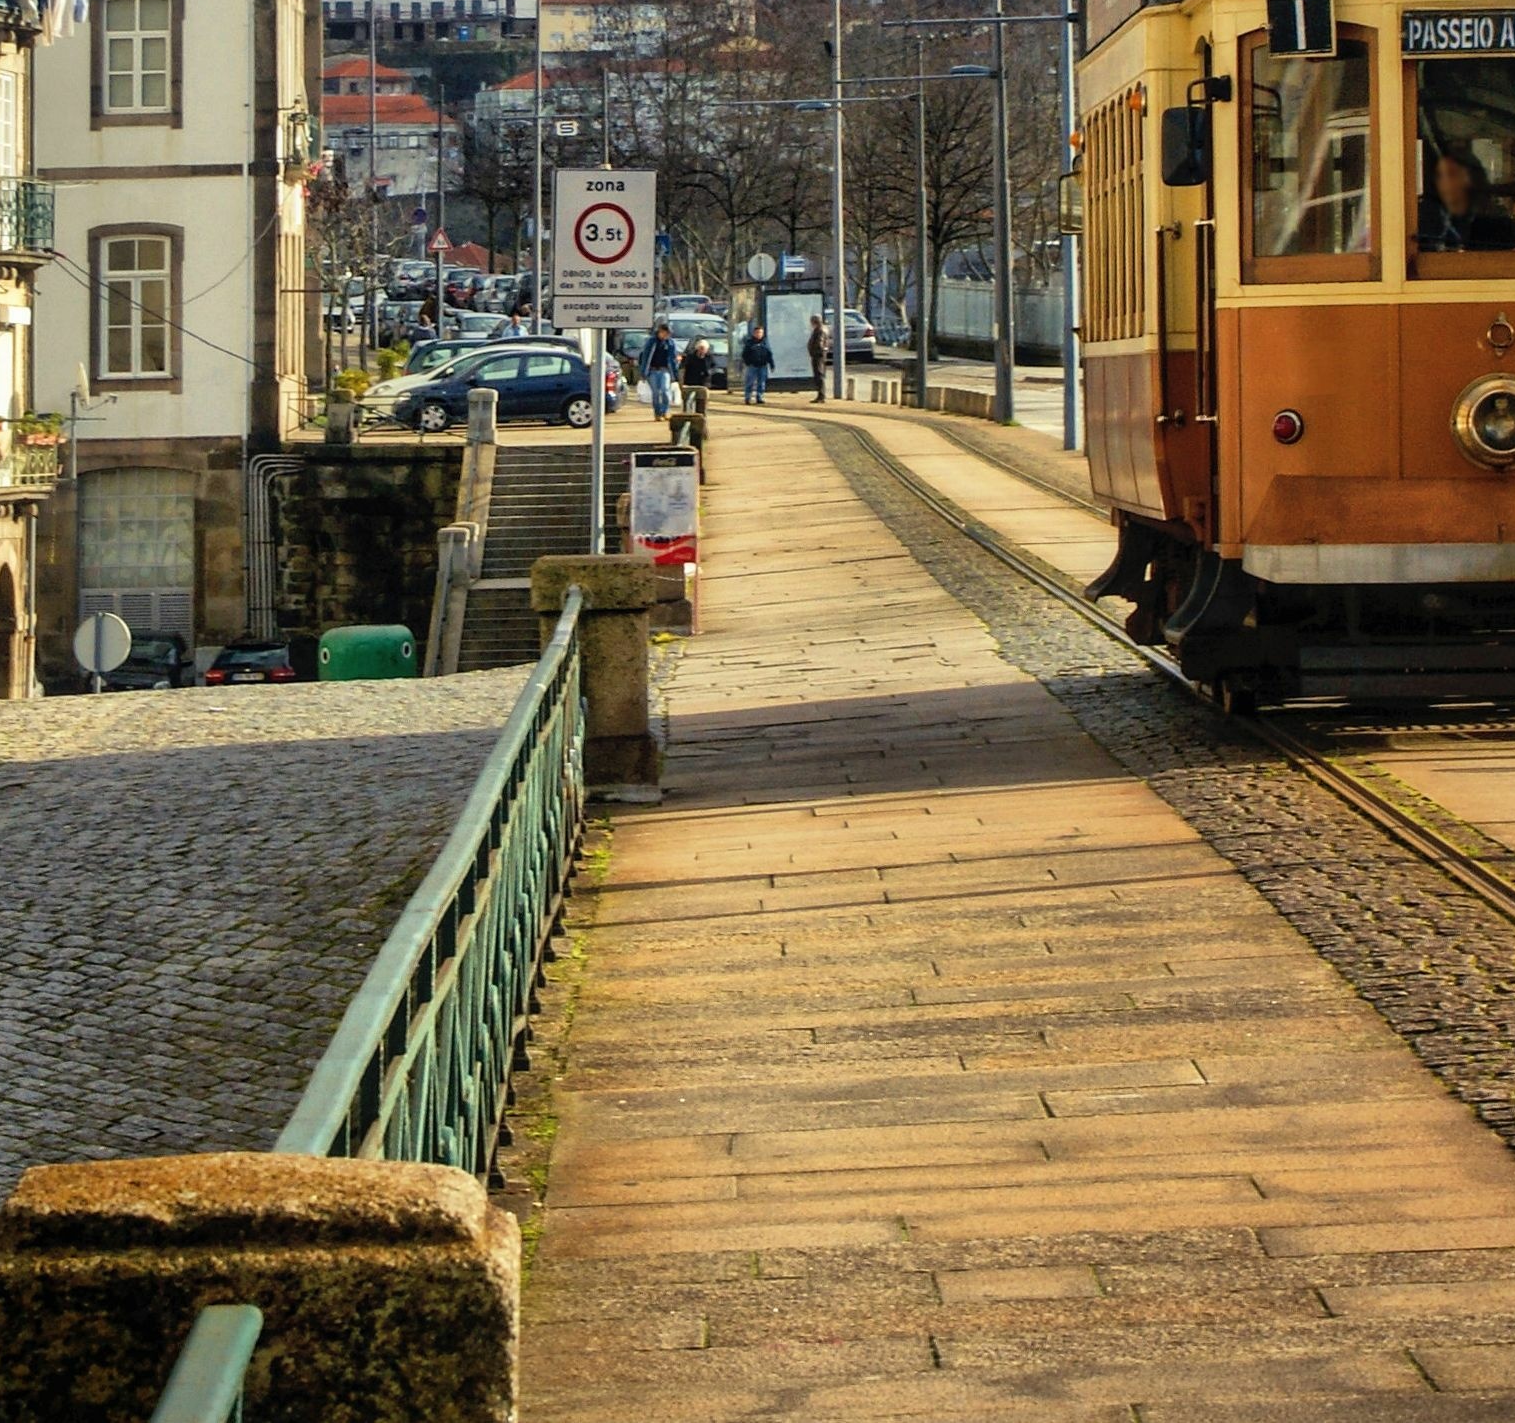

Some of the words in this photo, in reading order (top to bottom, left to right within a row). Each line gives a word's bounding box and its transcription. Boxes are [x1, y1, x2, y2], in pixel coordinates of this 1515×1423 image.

[1407, 15, 1494, 51] PASSEIO
[585, 180, 626, 193] zona
[584, 223, 624, 243] 3.5t
